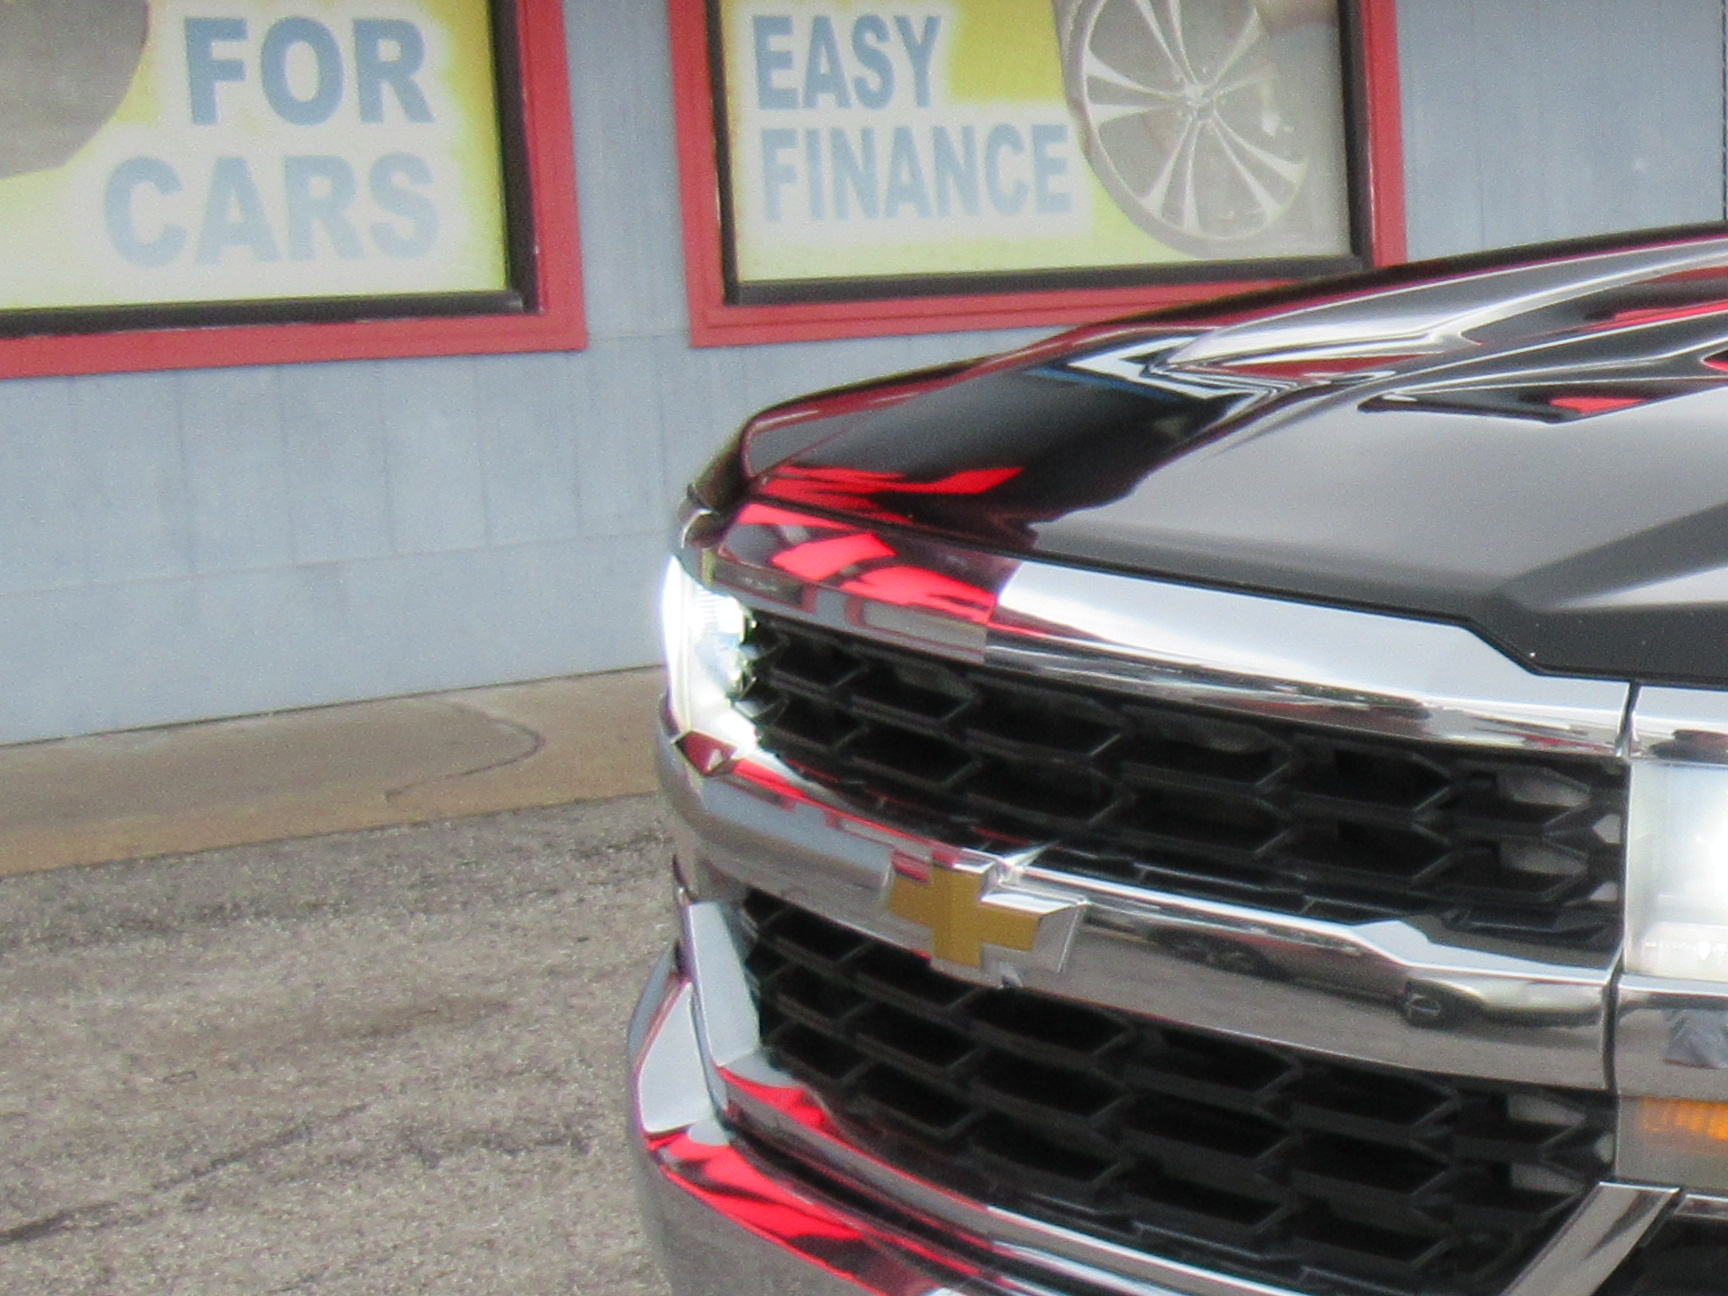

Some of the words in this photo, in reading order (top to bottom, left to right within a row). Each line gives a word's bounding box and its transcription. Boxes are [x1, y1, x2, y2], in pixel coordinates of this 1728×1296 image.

[183, 15, 436, 126] FOR
[752, 14, 942, 111] EASY
[103, 151, 441, 269] CARS
[760, 123, 1071, 223] FINANCE
